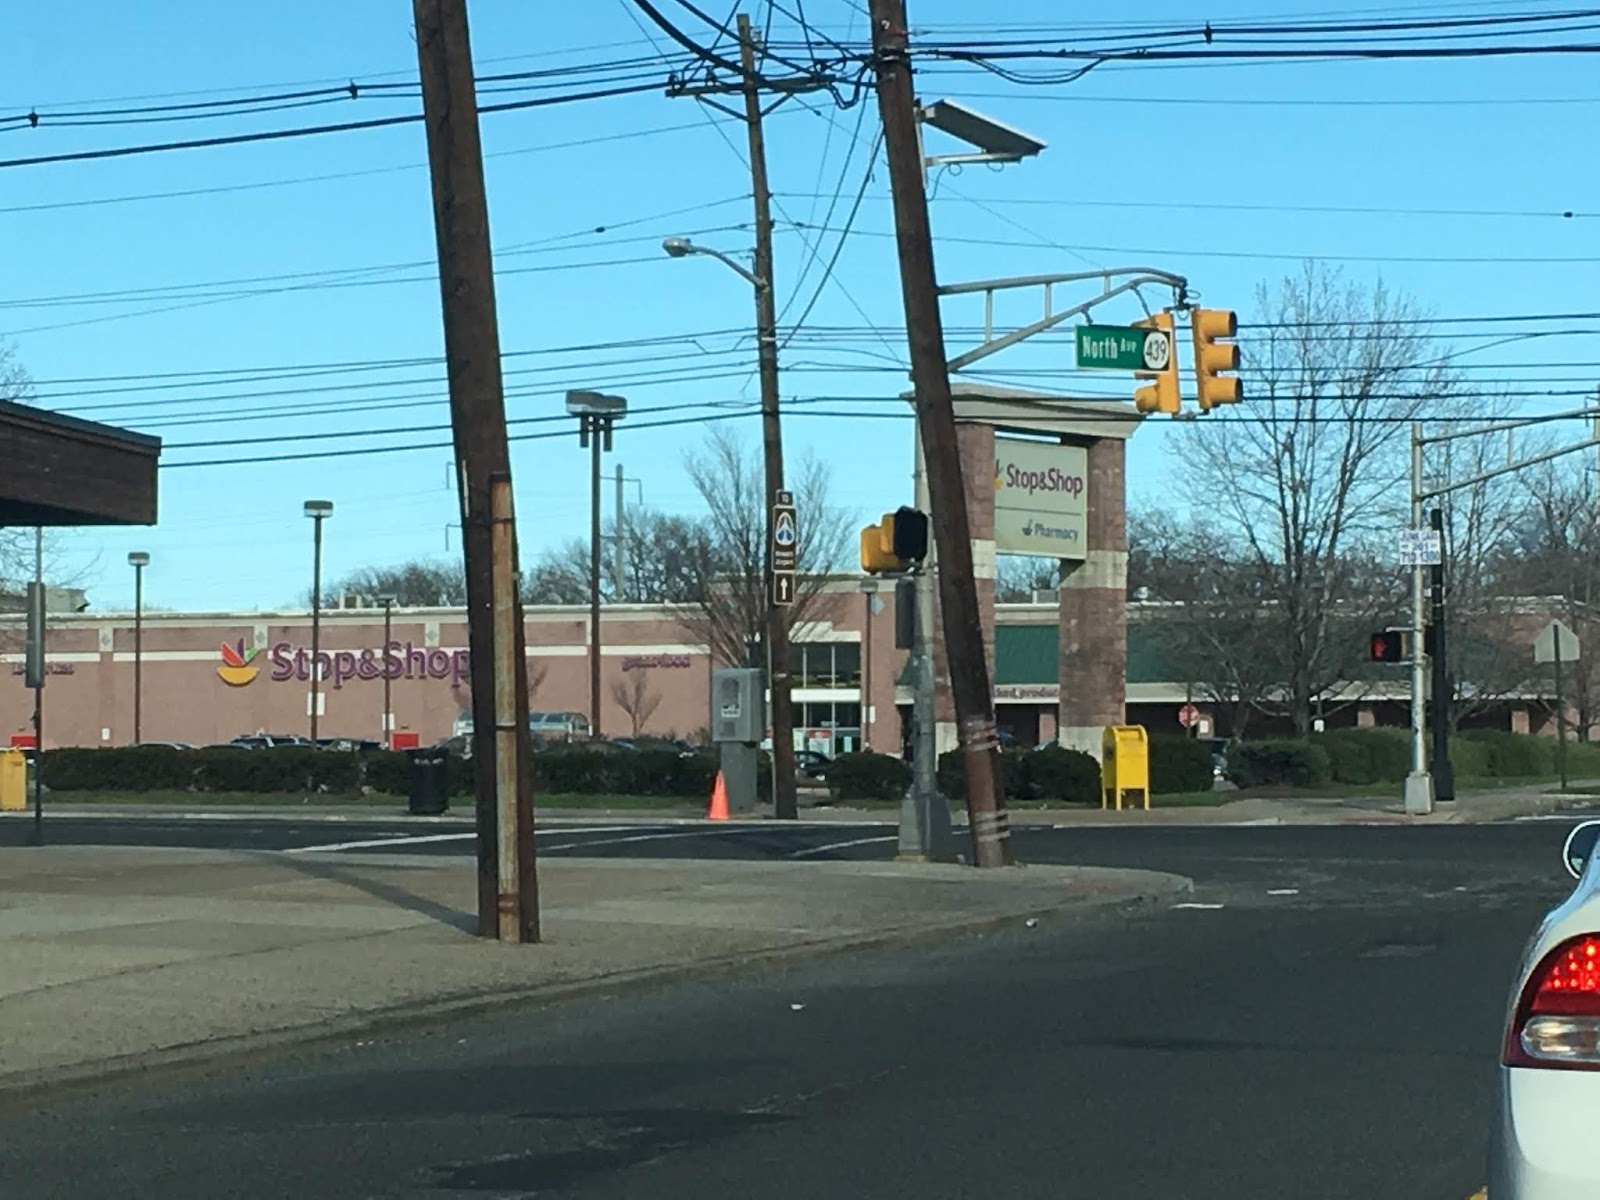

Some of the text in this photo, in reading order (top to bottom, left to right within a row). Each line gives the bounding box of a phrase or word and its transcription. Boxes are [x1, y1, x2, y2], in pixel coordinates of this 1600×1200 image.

[1082, 335, 1167, 362] North Ave 439
[1006, 462, 1083, 500] Stop&Shop
[1034, 522, 1078, 542] Pharmacy
[270, 641, 470, 689] Stop&Shop
